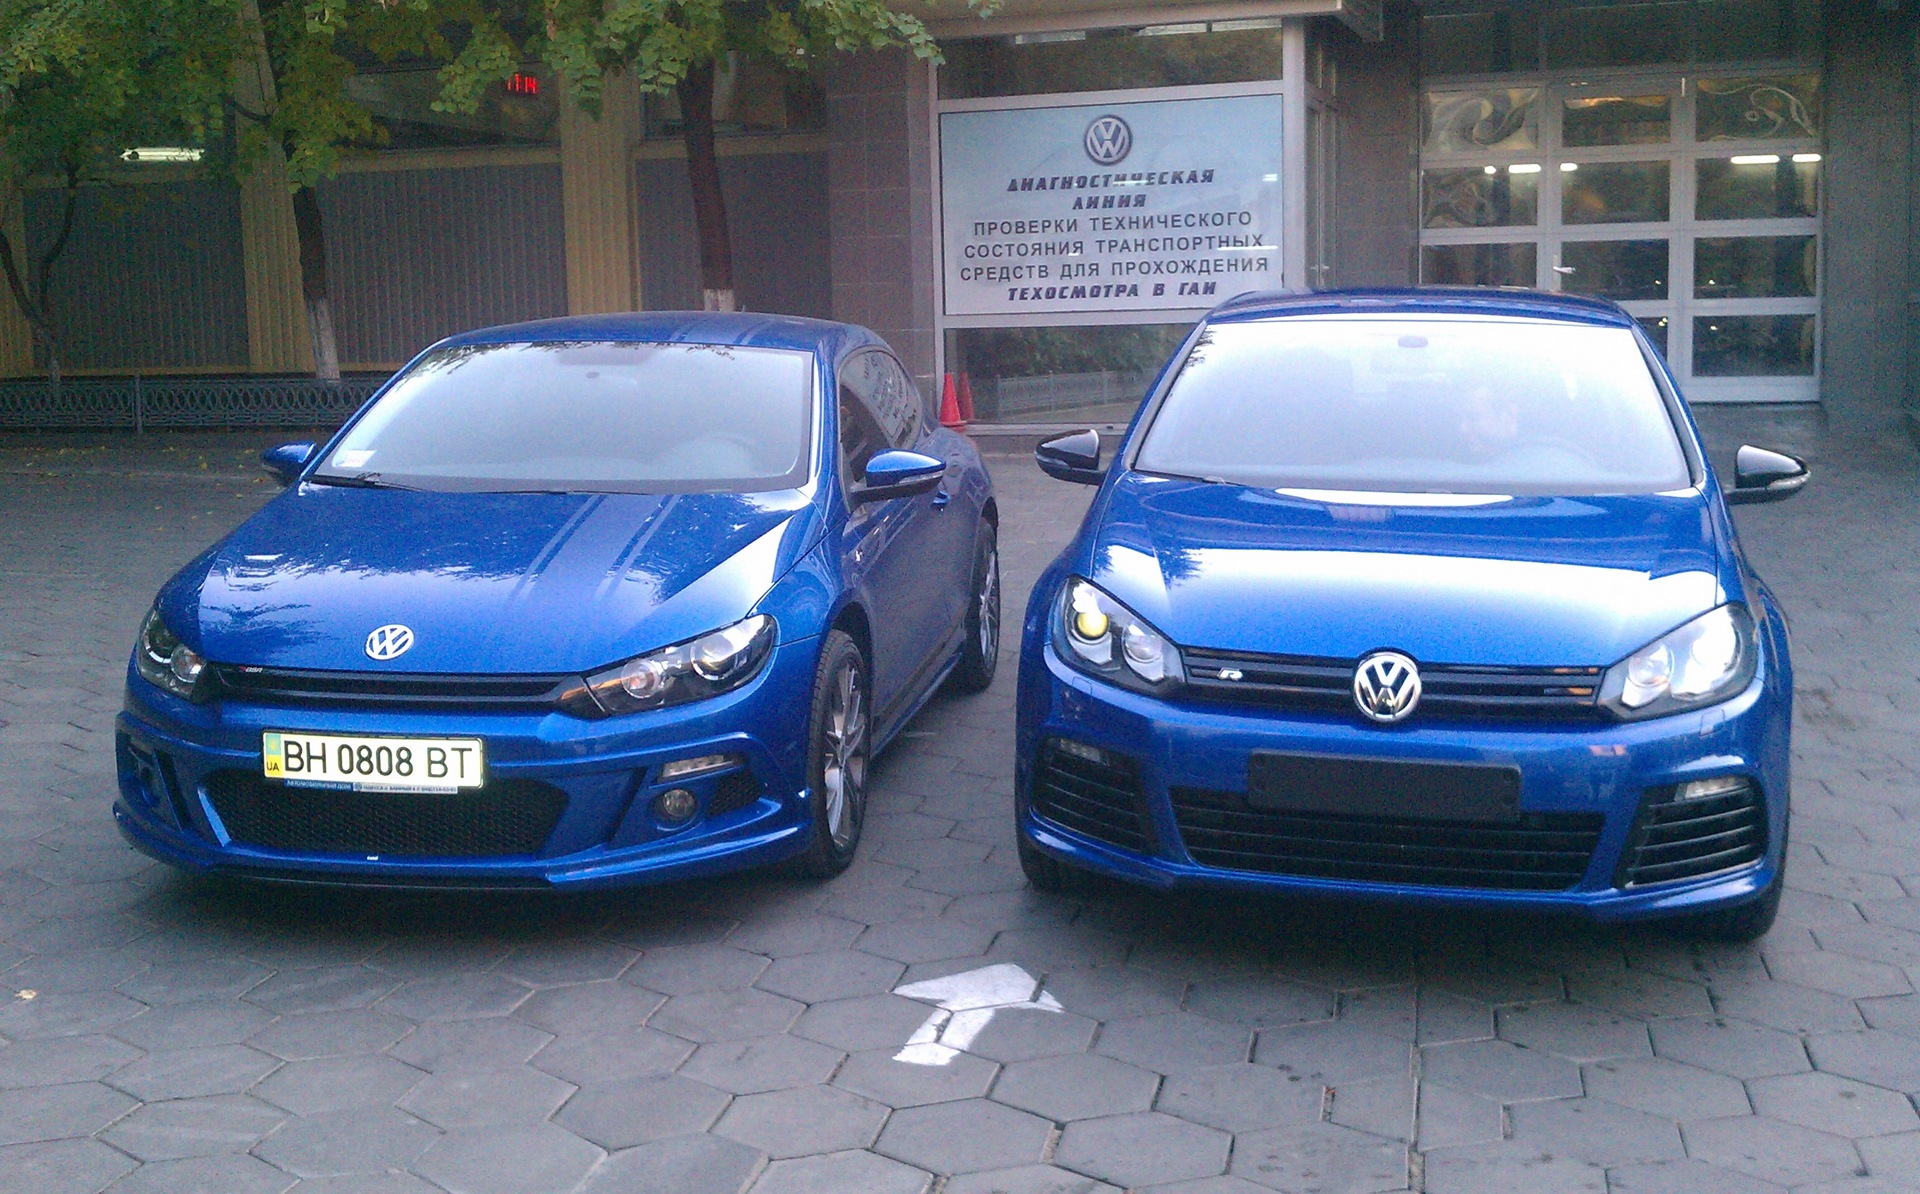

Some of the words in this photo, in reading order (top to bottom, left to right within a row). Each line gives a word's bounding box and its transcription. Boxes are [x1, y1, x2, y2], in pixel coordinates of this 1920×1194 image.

[1007, 169, 1214, 192] ДИАГНОСТИЧЕСКАЯ
[1072, 194, 1147, 211] ЛИНИЯ
[974, 219, 1078, 236] ПРОВЕРКИ
[1089, 211, 1252, 231] ТЕХНИЧЕСКОГО
[964, 241, 1084, 258] СОСТОЯНИЯ
[1095, 234, 1264, 254] ТРАНСПОРТНЫХ
[960, 266, 1049, 282] СРЕДСТВ
[1060, 264, 1100, 280] ДЛЯ
[1111, 257, 1268, 277] ПРОХОЖДЕНИЯ
[1008, 284, 1139, 301] ТЕХОСМОТРА
[1152, 285, 1165, 297] В
[266, 761, 280, 772] UA
[284, 740, 327, 774] BH
[337, 743, 414, 777] 0808
[426, 747, 473, 779] BT
